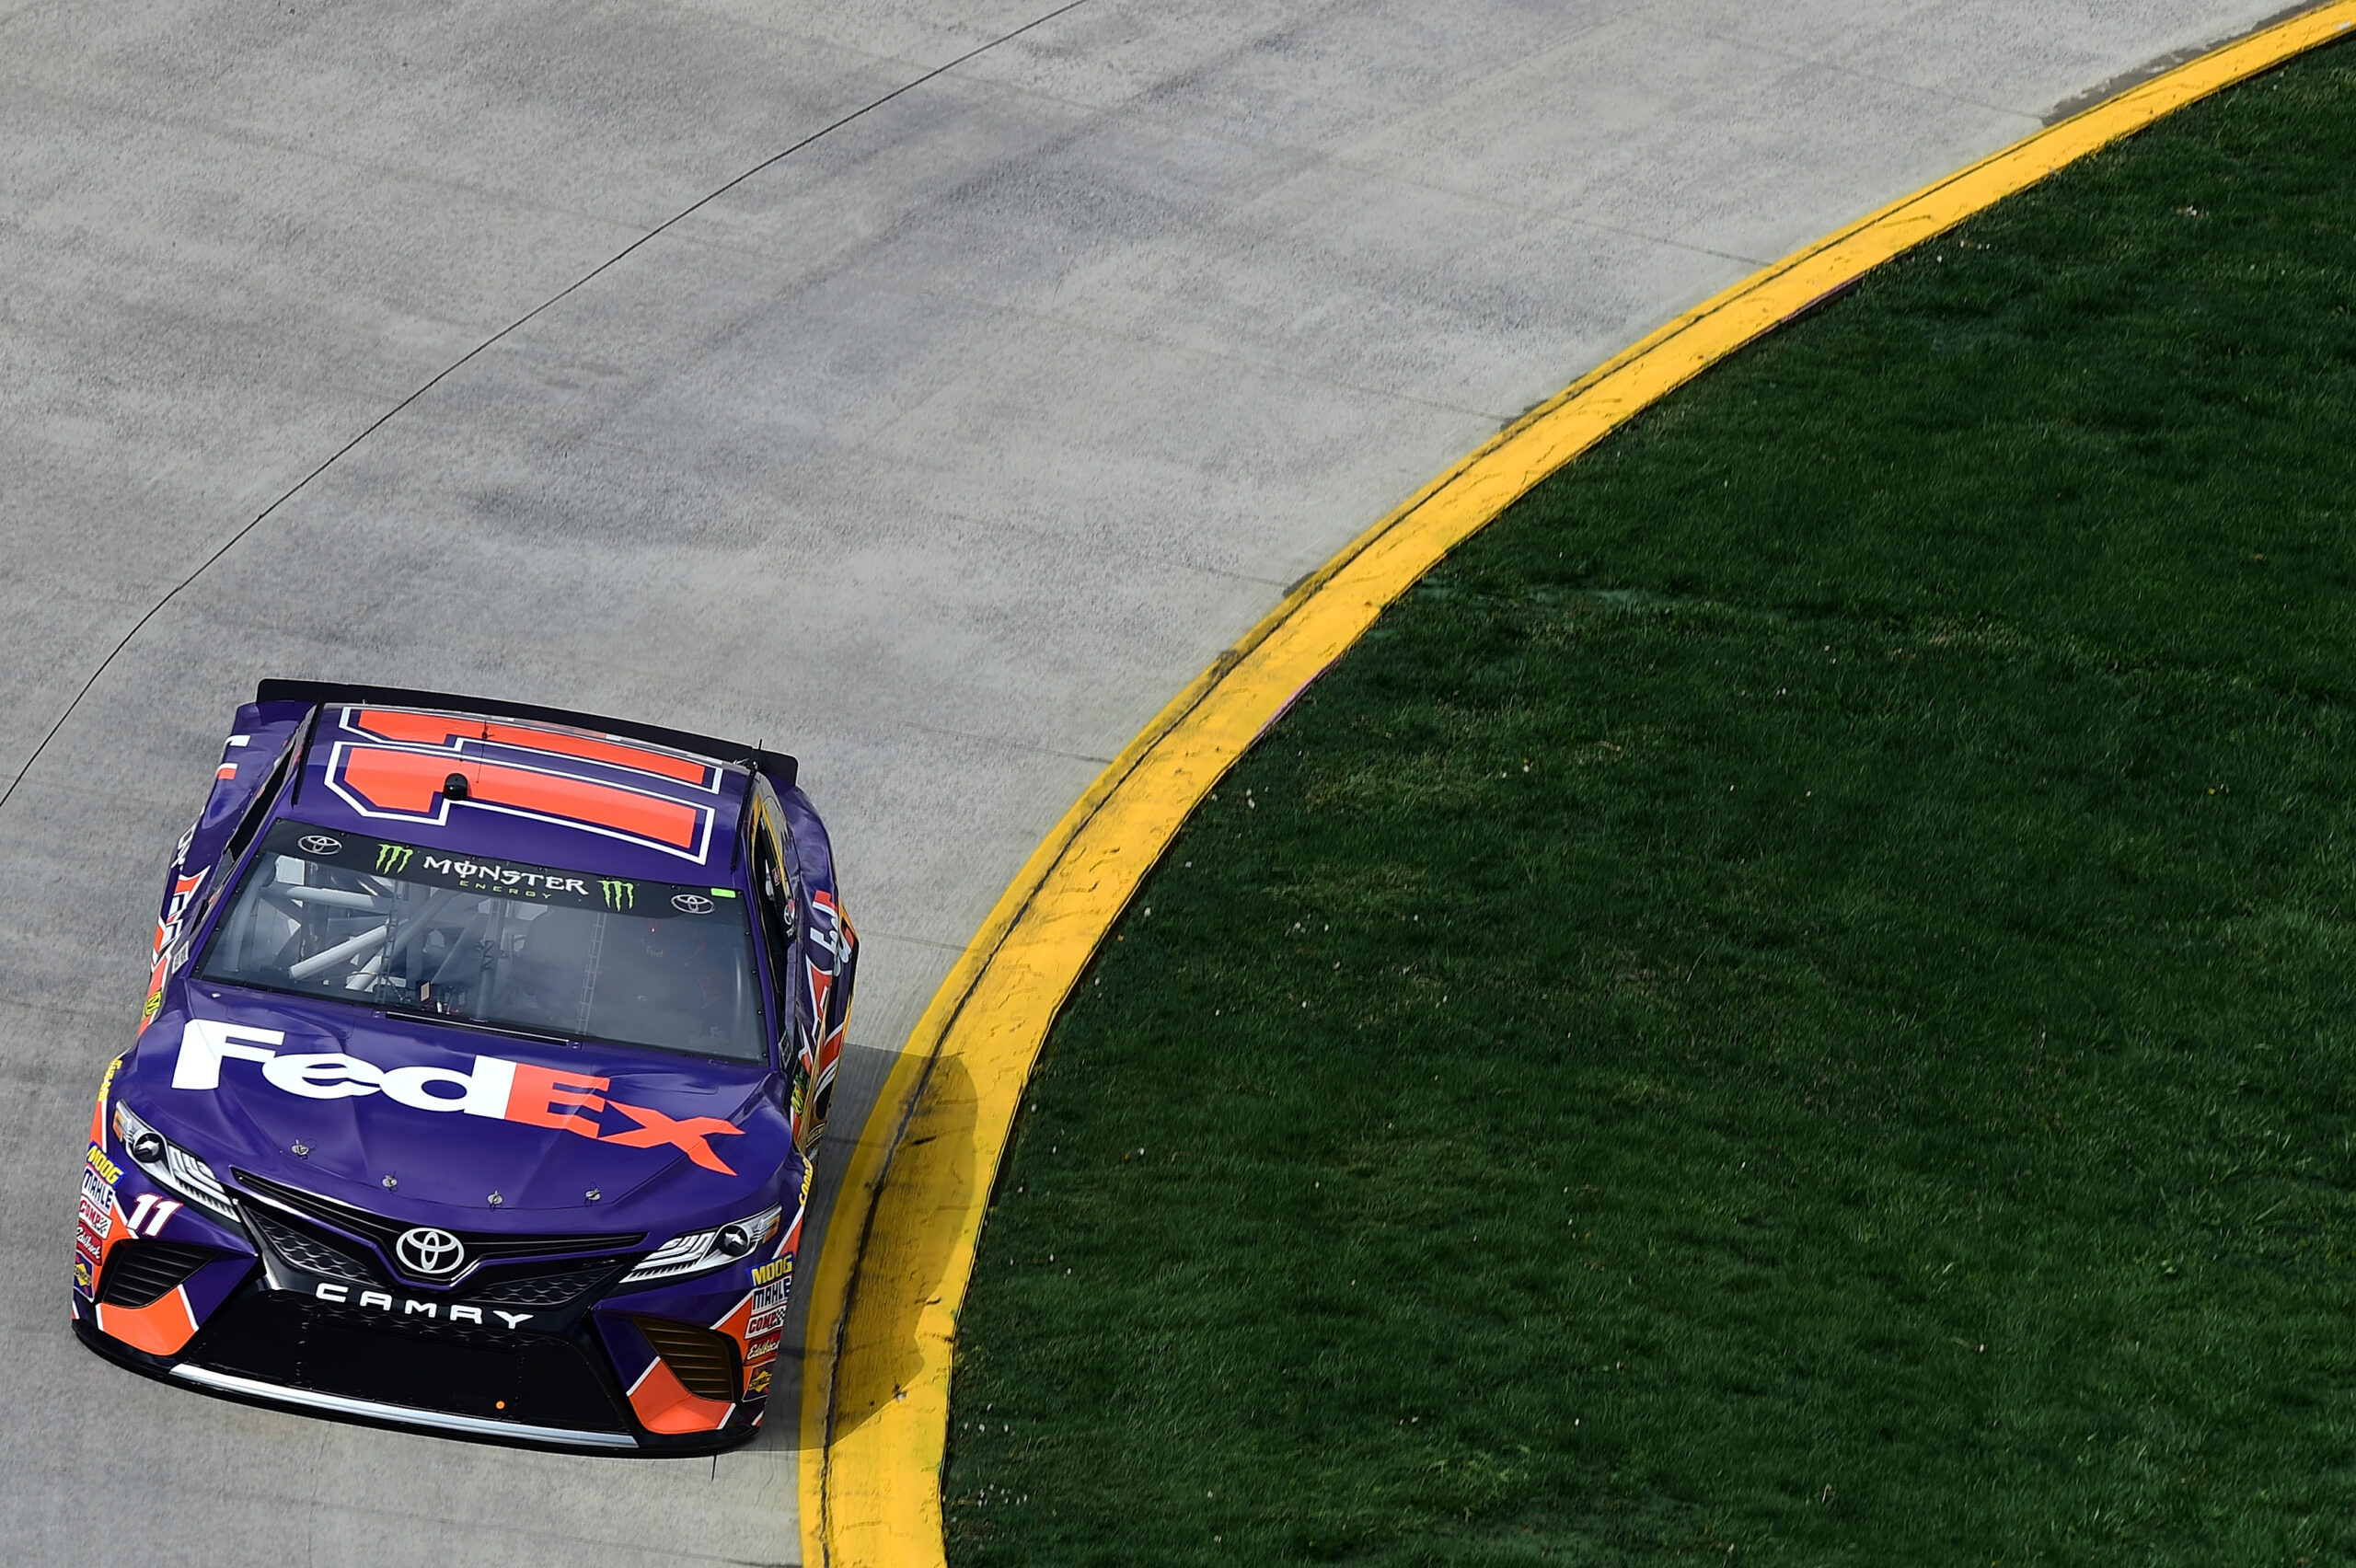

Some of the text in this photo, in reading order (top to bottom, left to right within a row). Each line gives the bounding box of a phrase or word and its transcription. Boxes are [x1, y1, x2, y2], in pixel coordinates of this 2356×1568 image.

[423, 856, 590, 896] MONSTER
[459, 880, 552, 900] ENERGY
[171, 1019, 746, 1177] FedEx
[87, 1145, 124, 1185] MOOG
[84, 1167, 113, 1209] MAHLE
[79, 1199, 101, 1224] COMP
[126, 1193, 184, 1239] 11
[751, 1253, 793, 1287] MOOG
[315, 1283, 535, 1330] CAMRY
[753, 1278, 791, 1310] MAHLE
[747, 1313, 777, 1334] COMP
